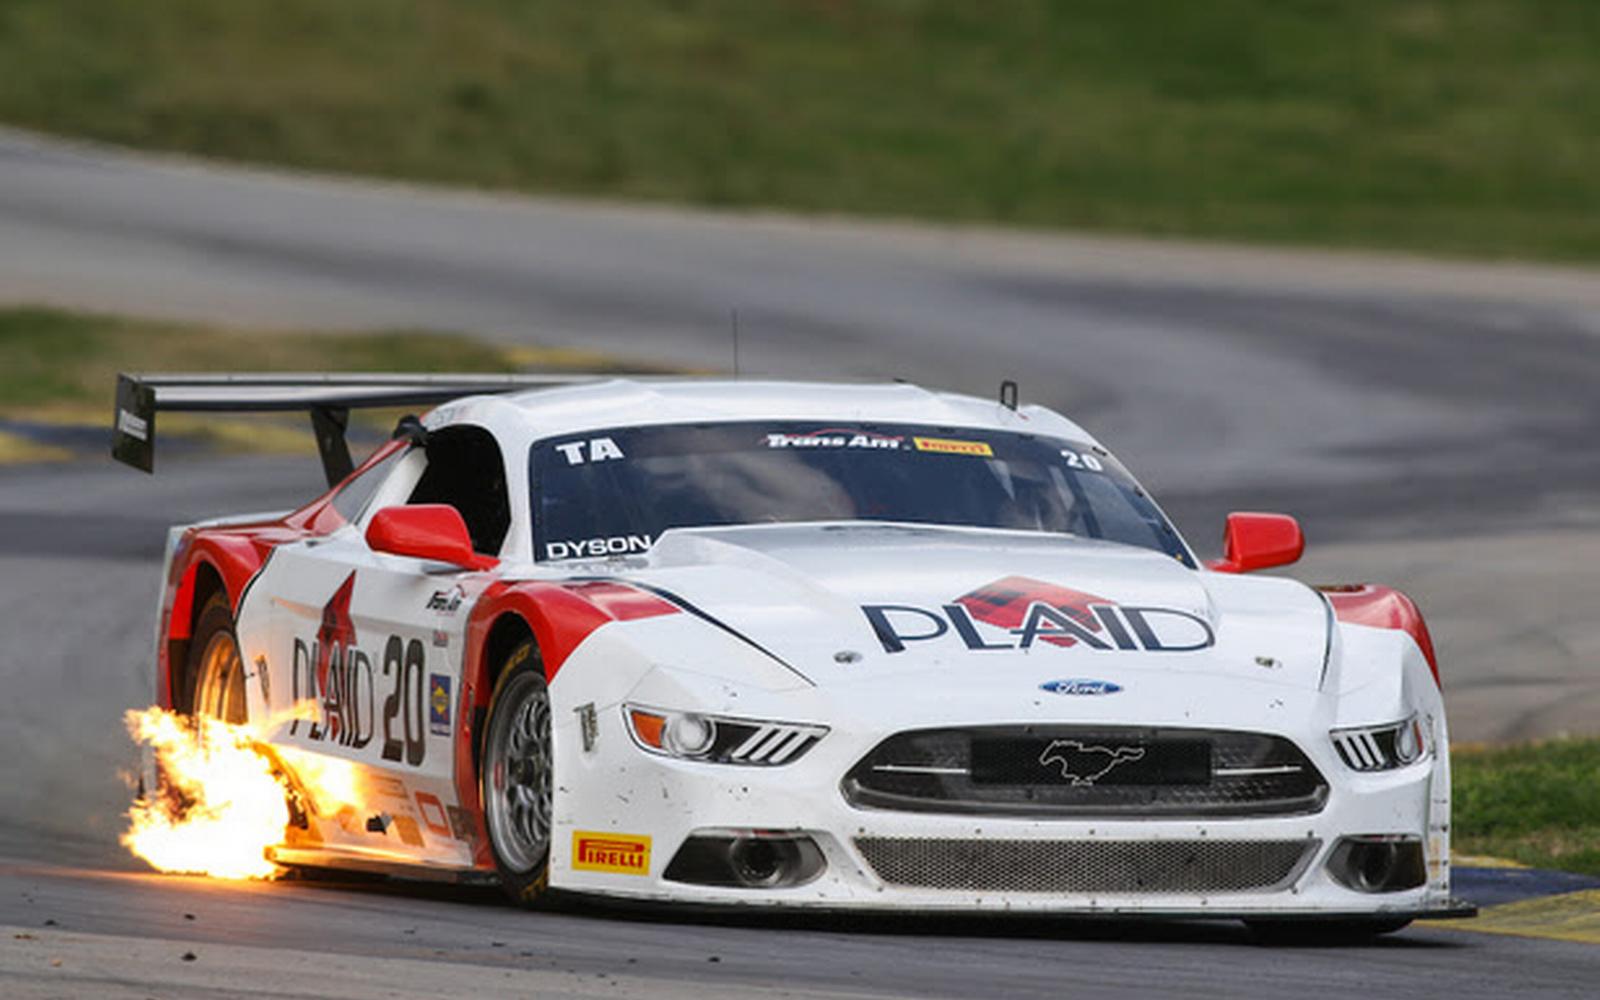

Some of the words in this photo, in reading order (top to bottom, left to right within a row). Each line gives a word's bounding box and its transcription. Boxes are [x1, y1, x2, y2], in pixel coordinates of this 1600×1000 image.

[556, 438, 624, 465] TA
[767, 434, 845, 448] Trans
[848, 434, 899, 449] Am
[1061, 450, 1103, 471] 20
[547, 535, 652, 559] DYSON
[860, 603, 1216, 653] PLAID
[381, 634, 426, 767] 20
[1055, 680, 1106, 697] Ford
[578, 838, 645, 868] PIRELLI
